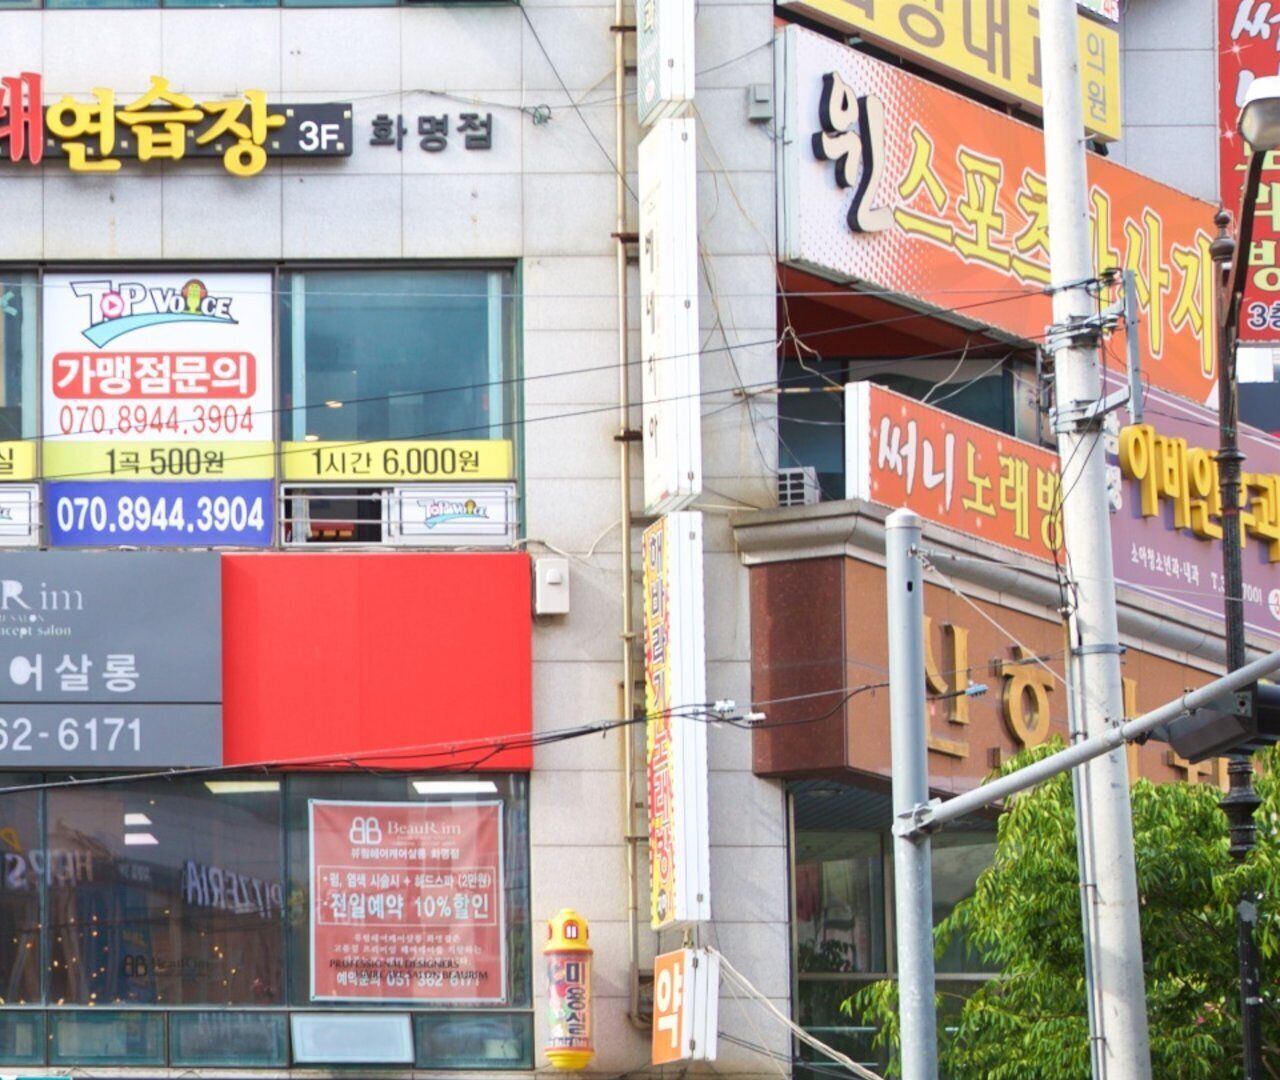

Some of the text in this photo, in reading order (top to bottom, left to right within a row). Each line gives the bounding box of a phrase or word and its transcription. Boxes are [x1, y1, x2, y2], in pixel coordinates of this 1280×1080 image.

[299, 122, 340, 151] 3F
[370, 112, 493, 152] 화명점
[57, 356, 248, 394] 가맹점문의
[59, 404, 254, 435] 070.8944.3904
[106, 447, 225, 475] 1곡 500원
[312, 447, 480, 477] 1시간 6,000원
[878, 416, 957, 514] 써니
[1119, 422, 1280, 564] 이비인과
[57, 496, 265, 532] 070.8944.3904
[37, 624, 72, 636] salon
[330, 893, 404, 920] 전일예약
[566, 963, 586, 1035] 미용실
[657, 962, 683, 1048] 약
